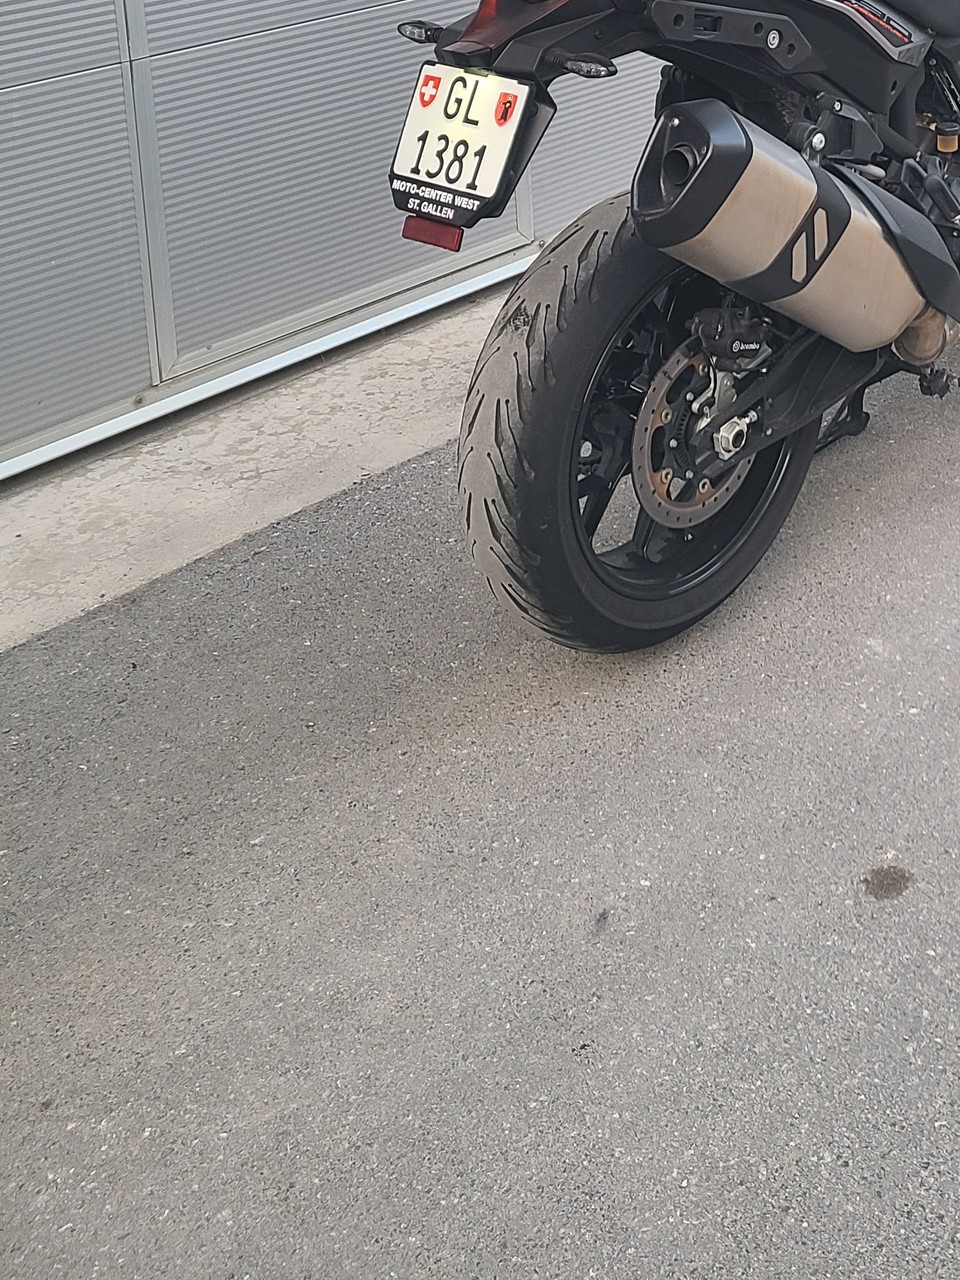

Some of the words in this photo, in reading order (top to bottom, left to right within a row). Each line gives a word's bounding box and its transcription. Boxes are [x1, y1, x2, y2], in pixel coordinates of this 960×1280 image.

[443, 76, 480, 126] GL
[410, 129, 487, 191] 1381
[392, 178, 454, 205] MOTO-CENTER
[454, 194, 480, 212] WEST
[407, 197, 421, 211] ST.
[420, 201, 455, 220] GALLEN
